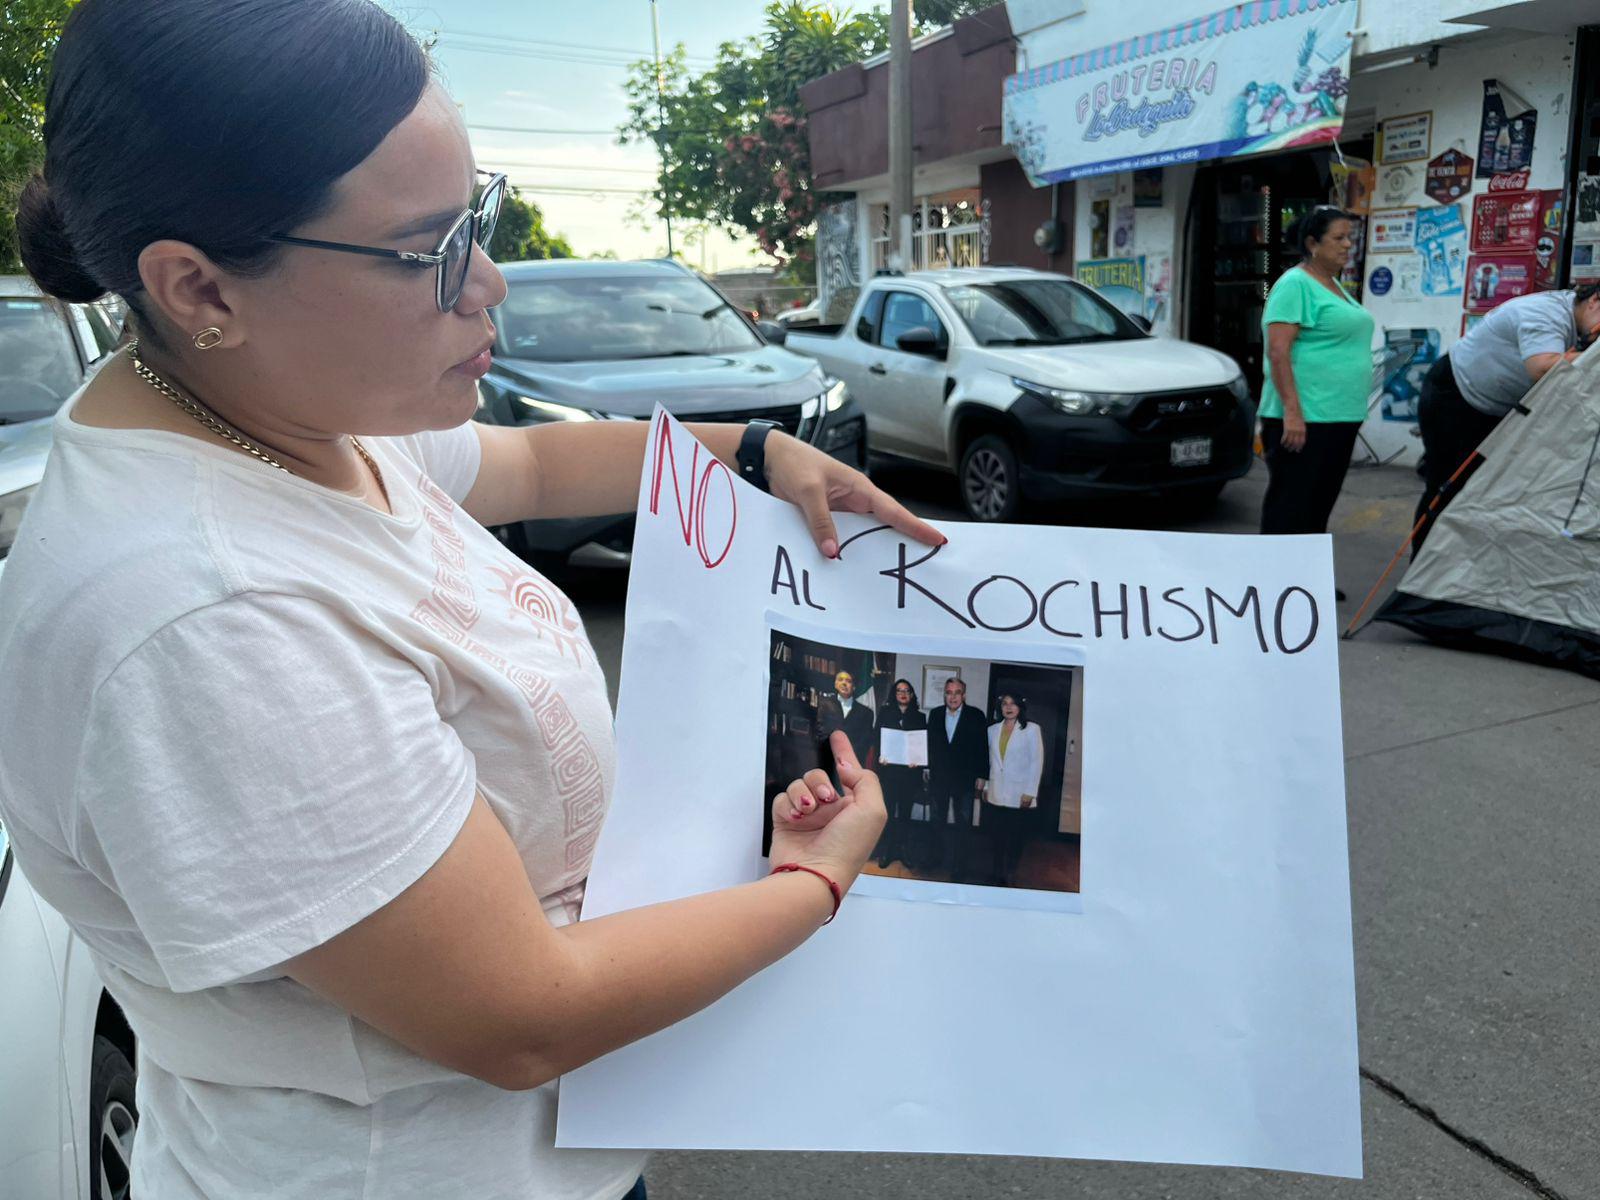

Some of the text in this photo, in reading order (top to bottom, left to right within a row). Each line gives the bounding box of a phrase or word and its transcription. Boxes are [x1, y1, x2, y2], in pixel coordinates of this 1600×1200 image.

[1076, 57, 1217, 124] FRUTERIA
[650, 409, 737, 568] NO
[771, 524, 1320, 654] AL ROCHISMO
